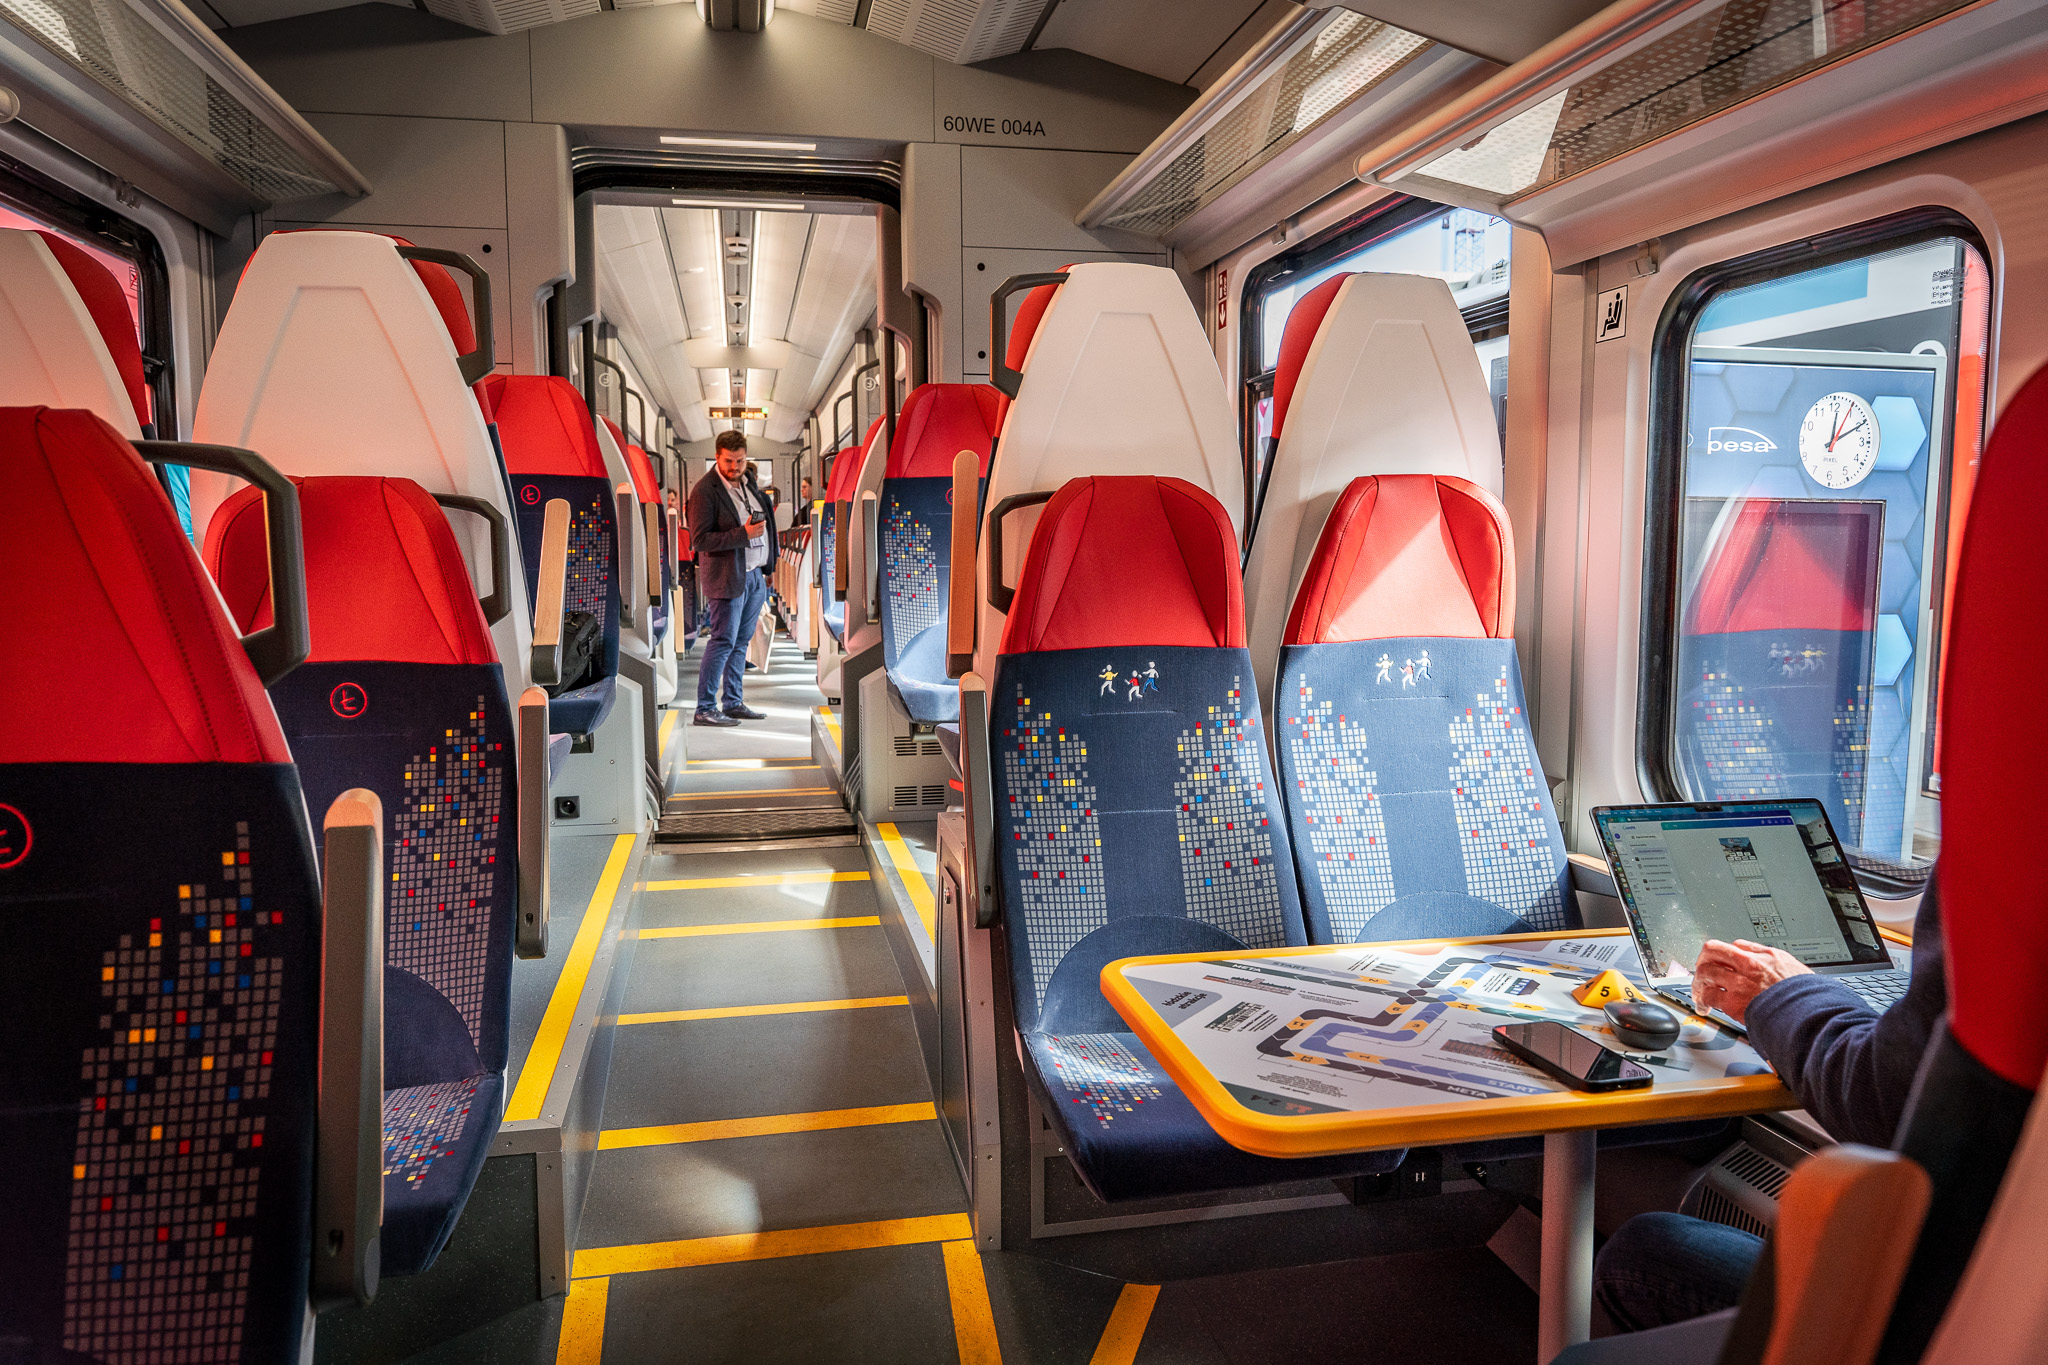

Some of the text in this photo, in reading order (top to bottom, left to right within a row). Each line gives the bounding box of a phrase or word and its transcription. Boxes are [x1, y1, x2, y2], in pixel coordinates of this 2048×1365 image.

[943, 115, 1046, 137] 60WE 004A
[1814, 407, 1825, 417] 11
[1829, 402, 1841, 413] 12
[1803, 420, 1814, 431] 10
[1799, 435, 1805, 446] 9
[1859, 436, 1866, 447] 3
[1801, 451, 1808, 462] 8
[1853, 453, 1860, 463] 4
[1812, 465, 1818, 475] 7
[1826, 470, 1833, 481] 6
[1842, 465, 1849, 477] 5
[1232, 963, 1261, 973] META
[1271, 961, 1309, 971] START
[1600, 985, 1611, 998] 5
[1624, 986, 1634, 998] 6
[1447, 1085, 1488, 1099] META
[1487, 1079, 1538, 1094] START
